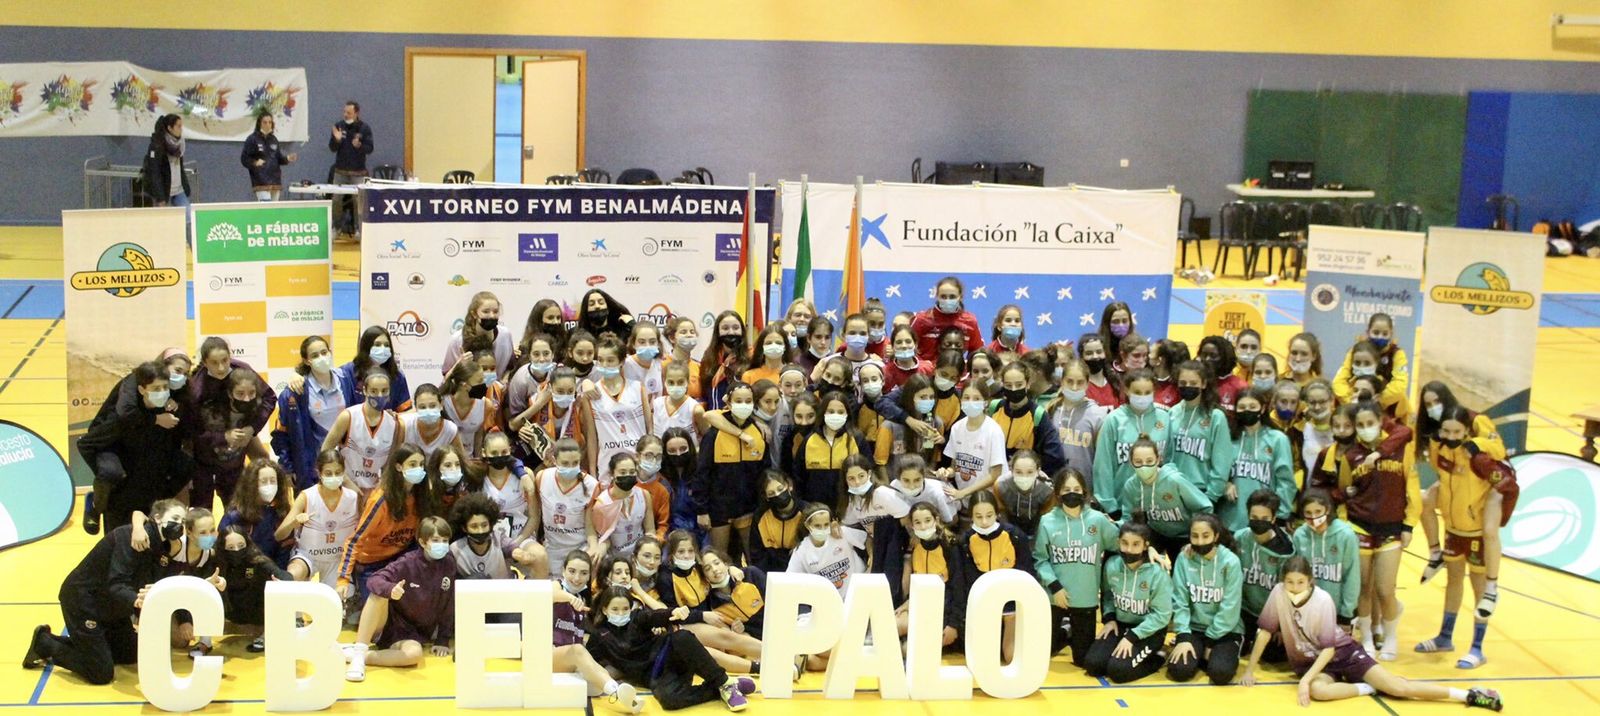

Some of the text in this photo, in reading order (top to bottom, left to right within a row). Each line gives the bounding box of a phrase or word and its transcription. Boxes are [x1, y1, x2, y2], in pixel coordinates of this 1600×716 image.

[383, 195, 743, 214] XVI TORNEO FYM BENALMÁDENA
[902, 219, 1017, 242] Fundación
[462, 240, 485, 248] FYM
[660, 239, 683, 248] FYM
[85, 273, 165, 286] LOS MELLIZOS
[1443, 290, 1520, 304] LOS MELLIZOS
[387, 320, 429, 337] PALO
[1058, 427, 1091, 448] PALO
[1173, 435, 1206, 461] EPONA
[760, 568, 1052, 700] PALO
